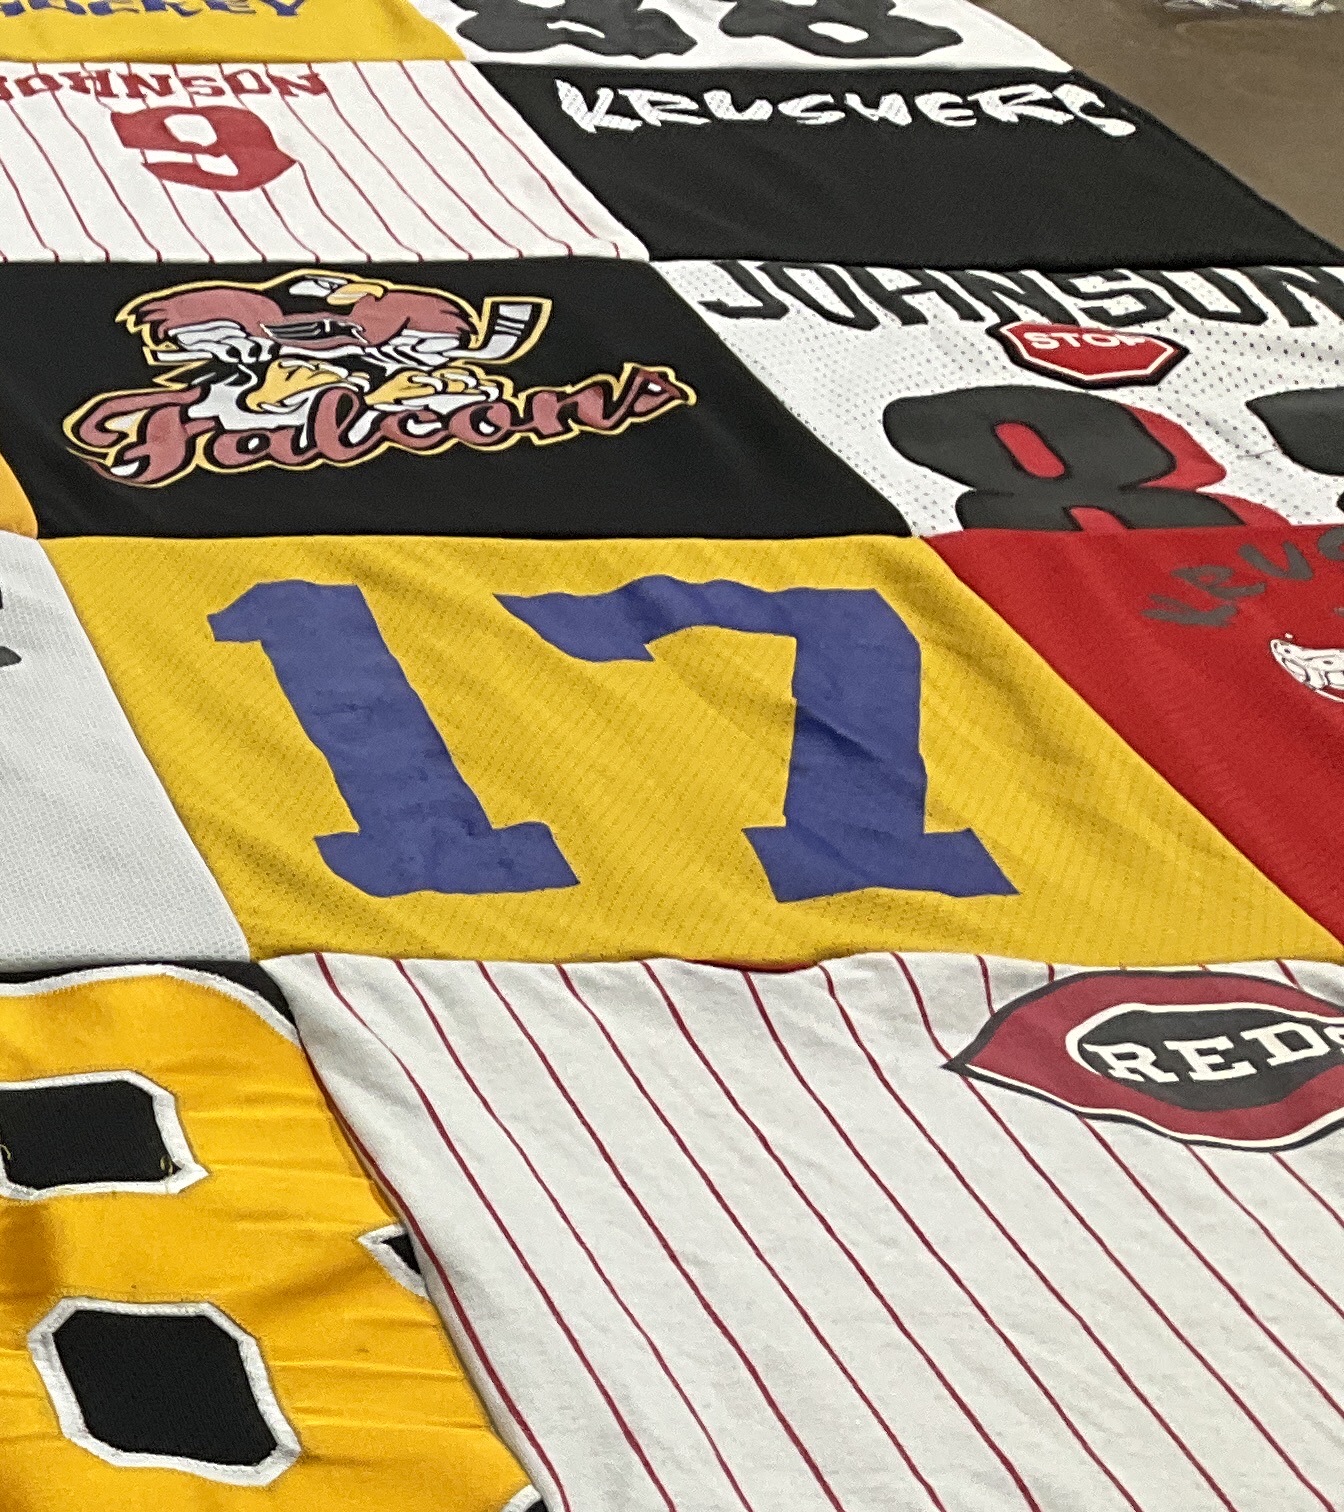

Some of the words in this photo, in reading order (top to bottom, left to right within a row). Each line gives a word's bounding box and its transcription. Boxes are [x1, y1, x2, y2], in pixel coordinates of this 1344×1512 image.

[554, 78, 1137, 137] KRUSHERS
[110, 106, 299, 192] 9
[698, 260, 1344, 332] JOHNSON
[1023, 331, 1147, 350] STOP
[63, 363, 696, 488] Falcons
[206, 573, 1022, 904] 17
